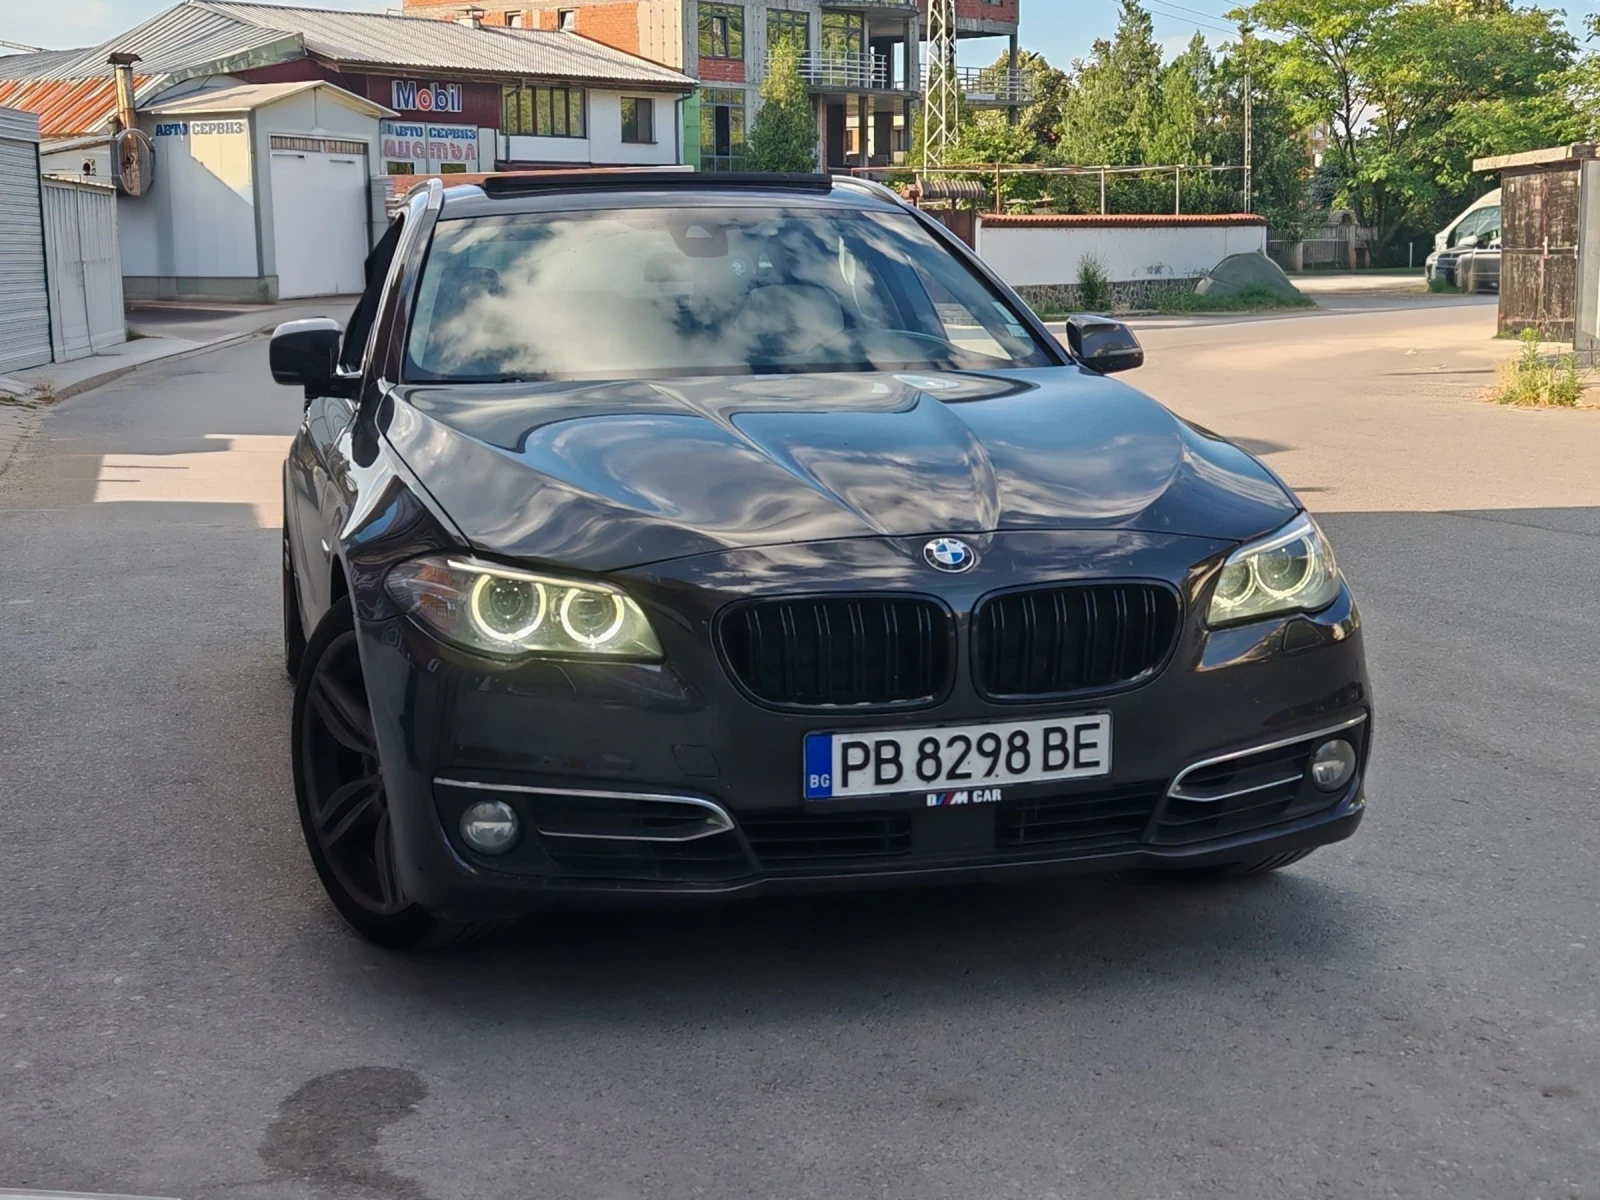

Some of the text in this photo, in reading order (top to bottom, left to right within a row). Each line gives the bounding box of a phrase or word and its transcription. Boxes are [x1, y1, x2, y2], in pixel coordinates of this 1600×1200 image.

[392, 80, 462, 112] Mobil
[155, 121, 244, 137] АВТО СЕРВИЗ
[429, 127, 476, 140] СЕРВИЗ
[840, 722, 1101, 789] PB 8298 BE
[809, 774, 831, 789] BG
[972, 788, 1002, 803] CAR
